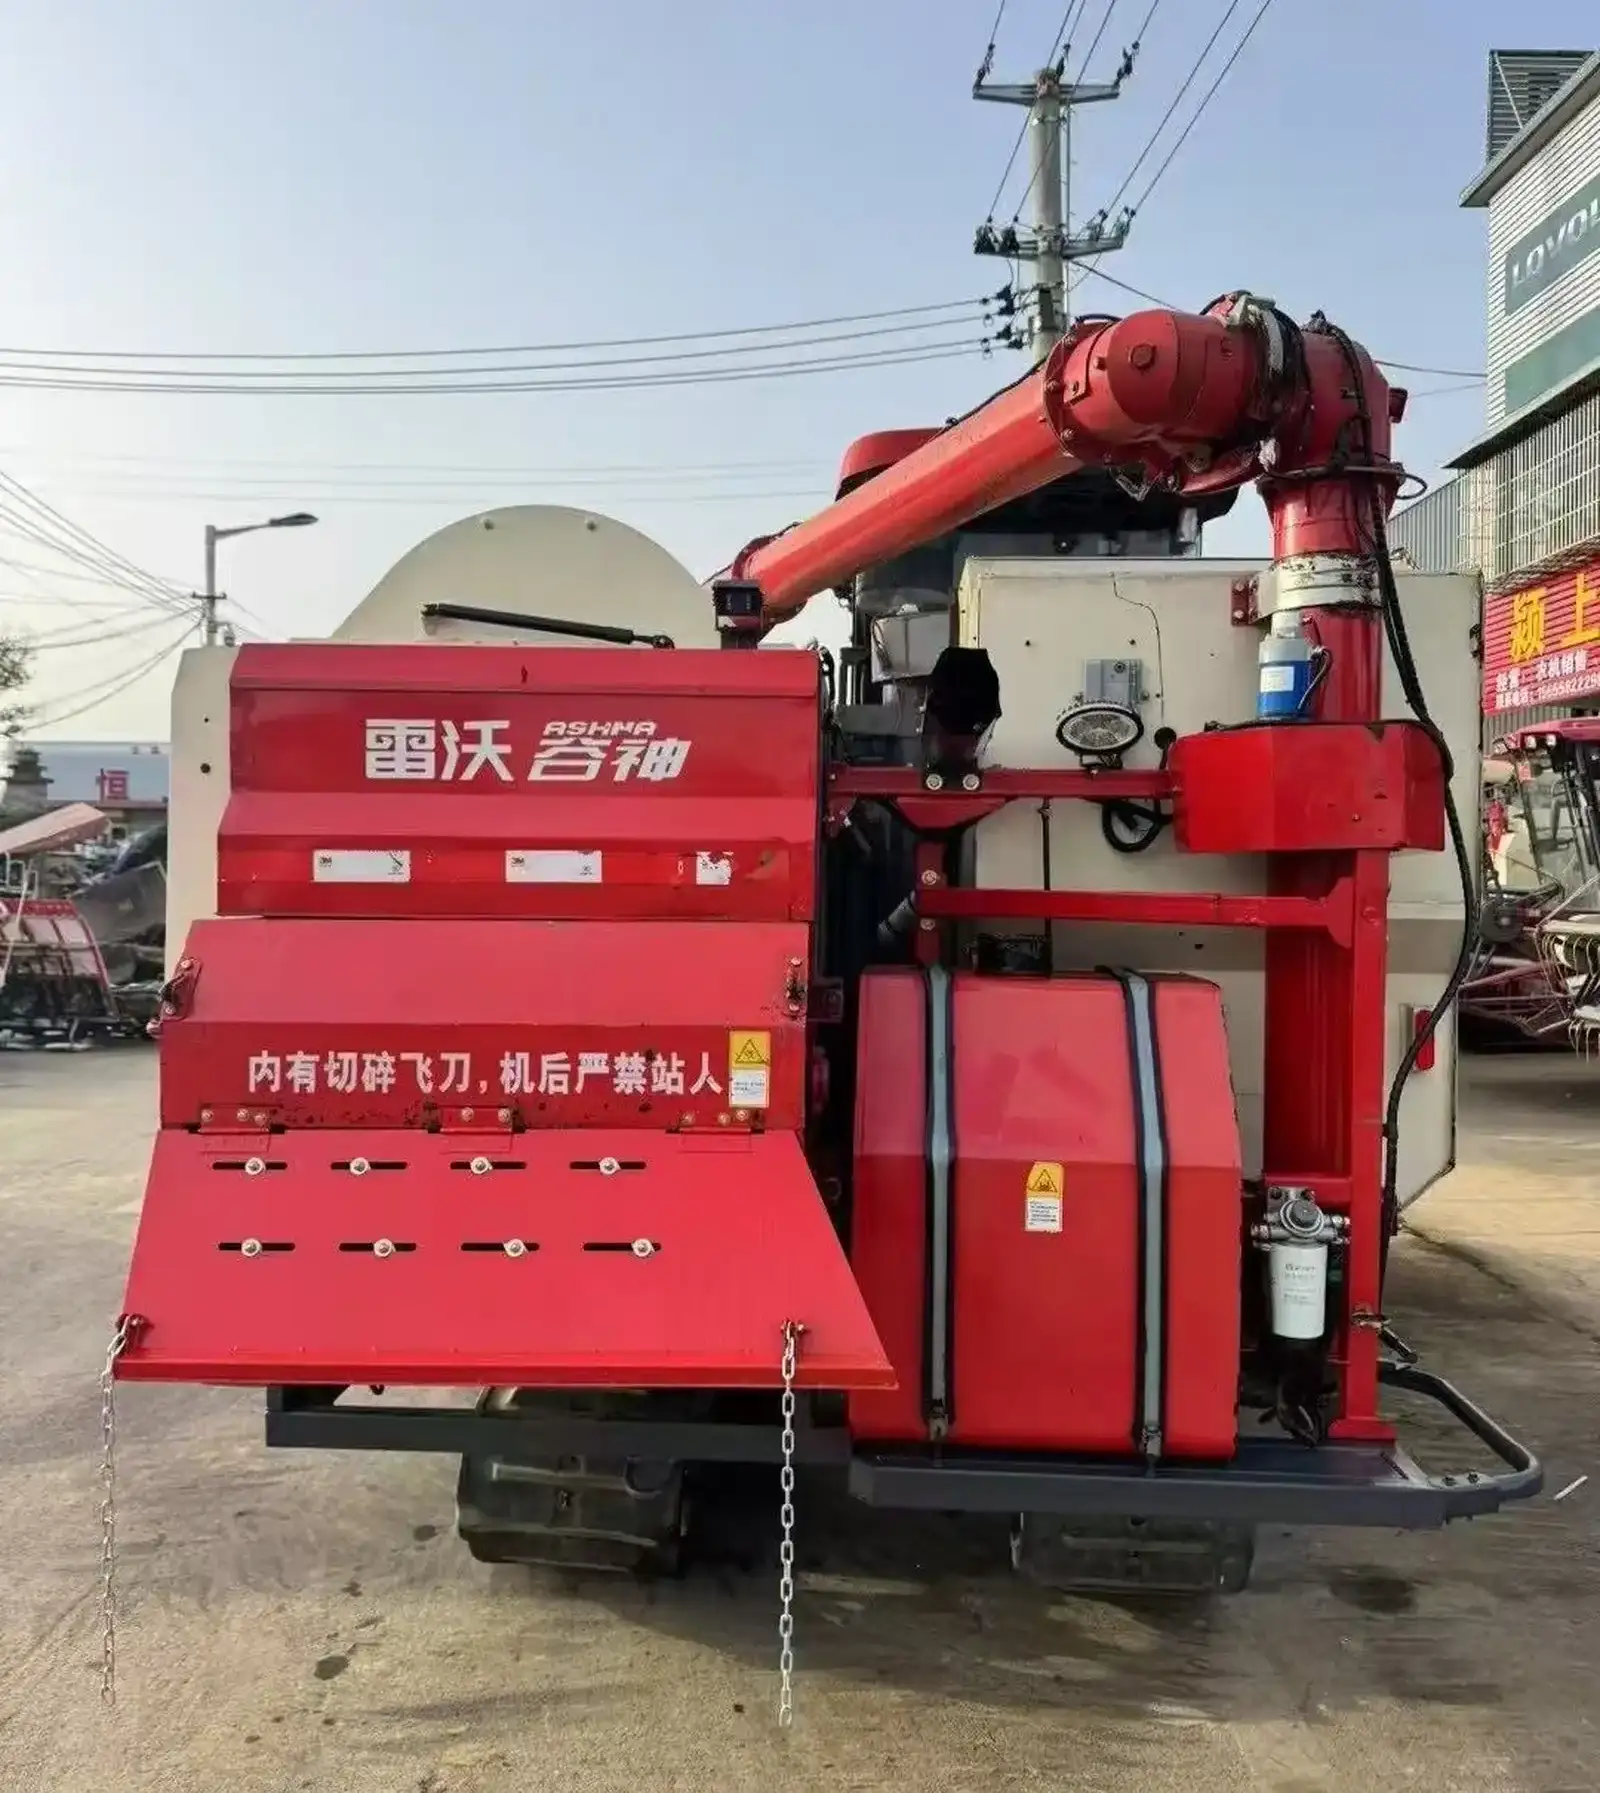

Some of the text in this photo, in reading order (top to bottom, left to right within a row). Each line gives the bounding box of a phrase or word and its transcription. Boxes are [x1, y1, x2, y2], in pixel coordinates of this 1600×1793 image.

[365, 719, 692, 781] 雷沃 谷神
[248, 1050, 723, 1095] 内有切碎飞刀，机后严禁站人
